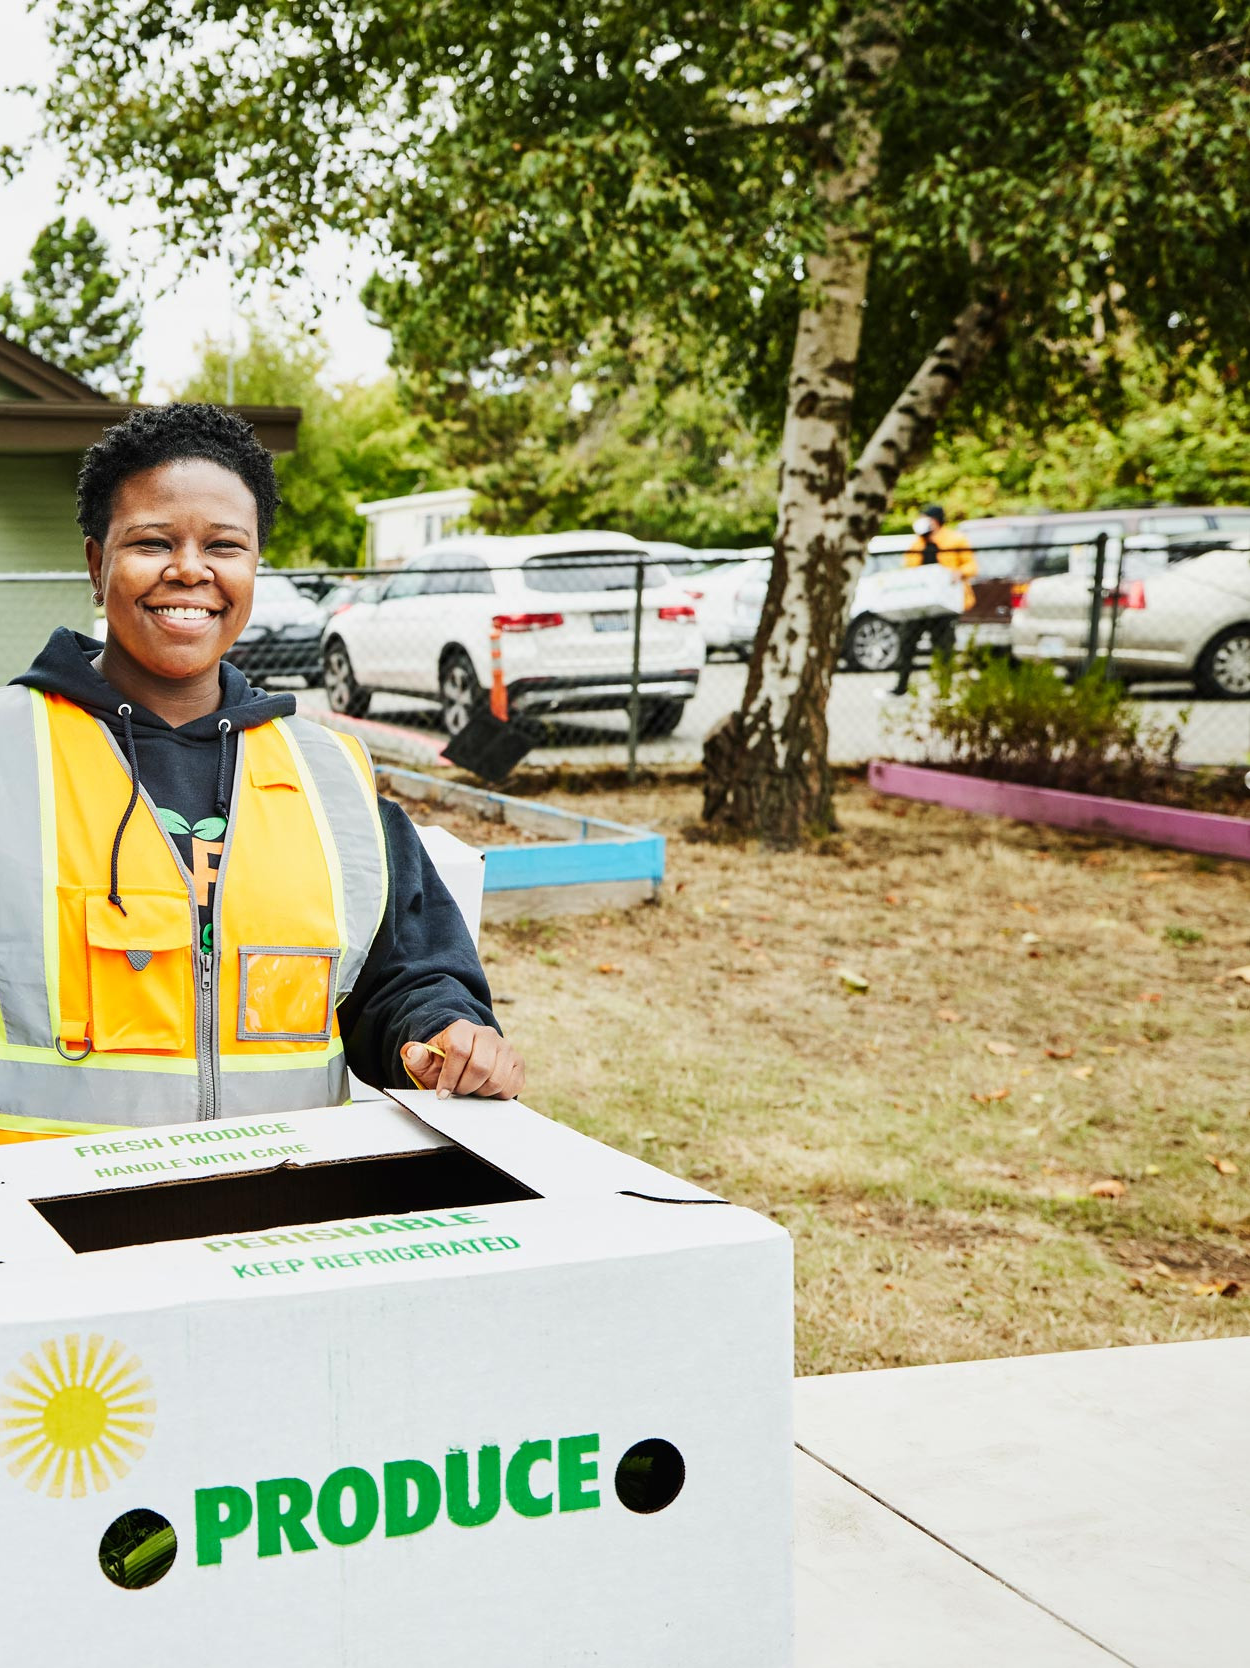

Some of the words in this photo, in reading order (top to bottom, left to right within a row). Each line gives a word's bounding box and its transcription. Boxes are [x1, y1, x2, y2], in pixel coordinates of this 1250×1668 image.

[74, 1137, 165, 1158] FRESH
[165, 1122, 298, 1147] PRODUCE
[94, 1159, 187, 1178] HANDLE
[187, 1151, 248, 1167] WITH
[250, 1143, 313, 1160] CARE
[202, 1211, 490, 1252] PERISHABLE
[232, 1258, 305, 1279] KEEP
[314, 1235, 523, 1270] REFRIGERATED
[194, 1433, 600, 1567] PRODUCE
